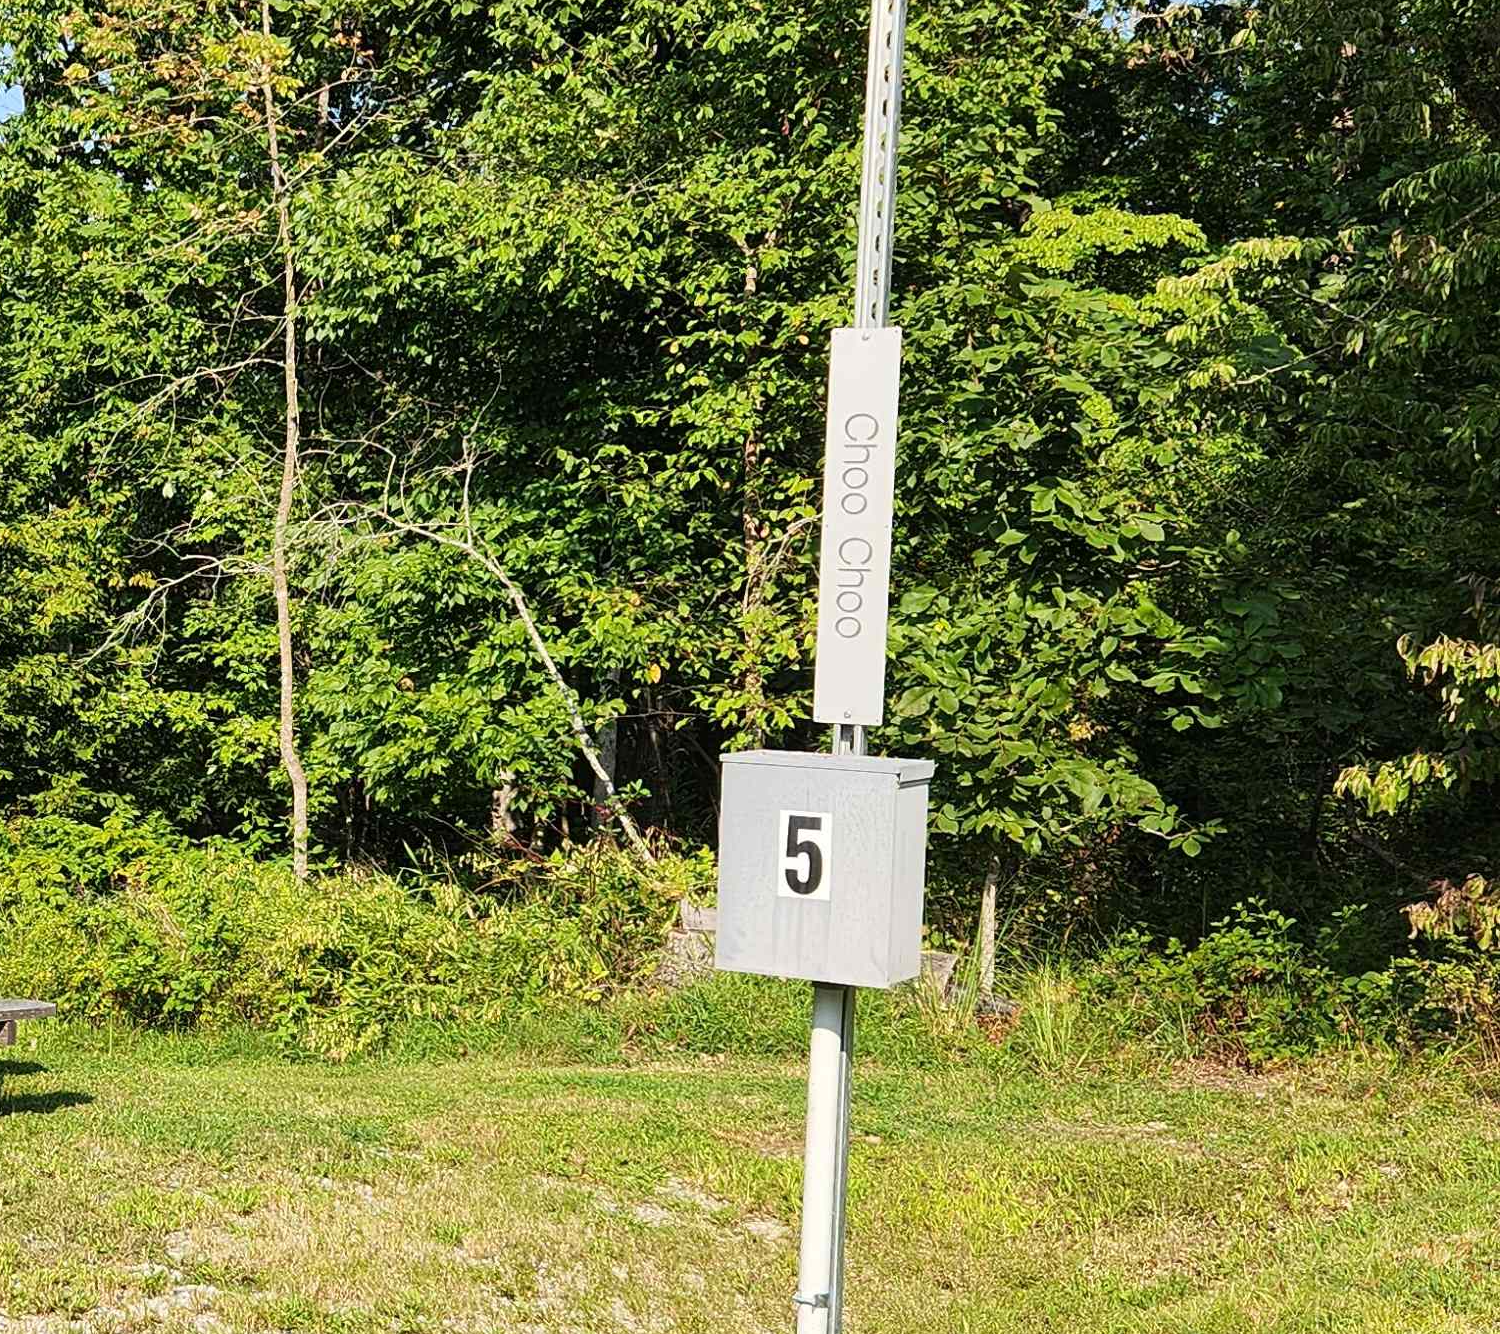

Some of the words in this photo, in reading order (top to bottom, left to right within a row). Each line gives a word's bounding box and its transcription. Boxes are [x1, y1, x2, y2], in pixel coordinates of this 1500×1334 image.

[841, 413, 879, 515] Choo
[835, 537, 873, 639] Choo
[785, 814, 823, 895] 5
